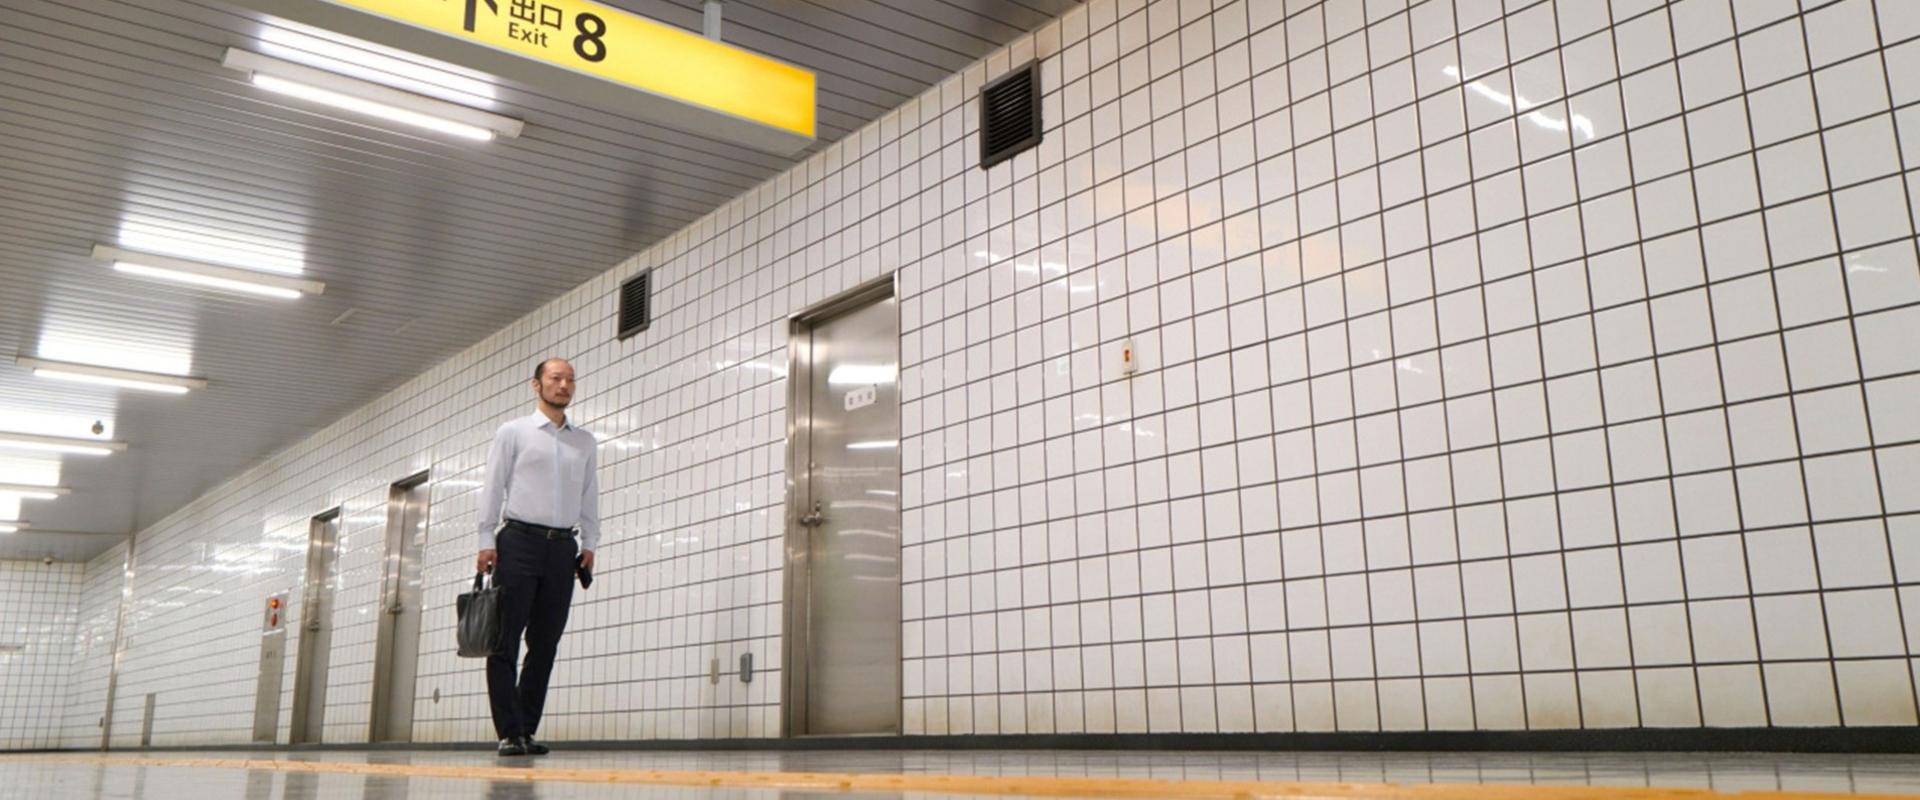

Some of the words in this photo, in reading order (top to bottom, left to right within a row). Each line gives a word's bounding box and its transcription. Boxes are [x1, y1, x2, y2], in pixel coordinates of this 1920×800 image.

[510, 0, 562, 30] 出口
[508, 23, 548, 48] Exit
[573, 12, 607, 63] 8
